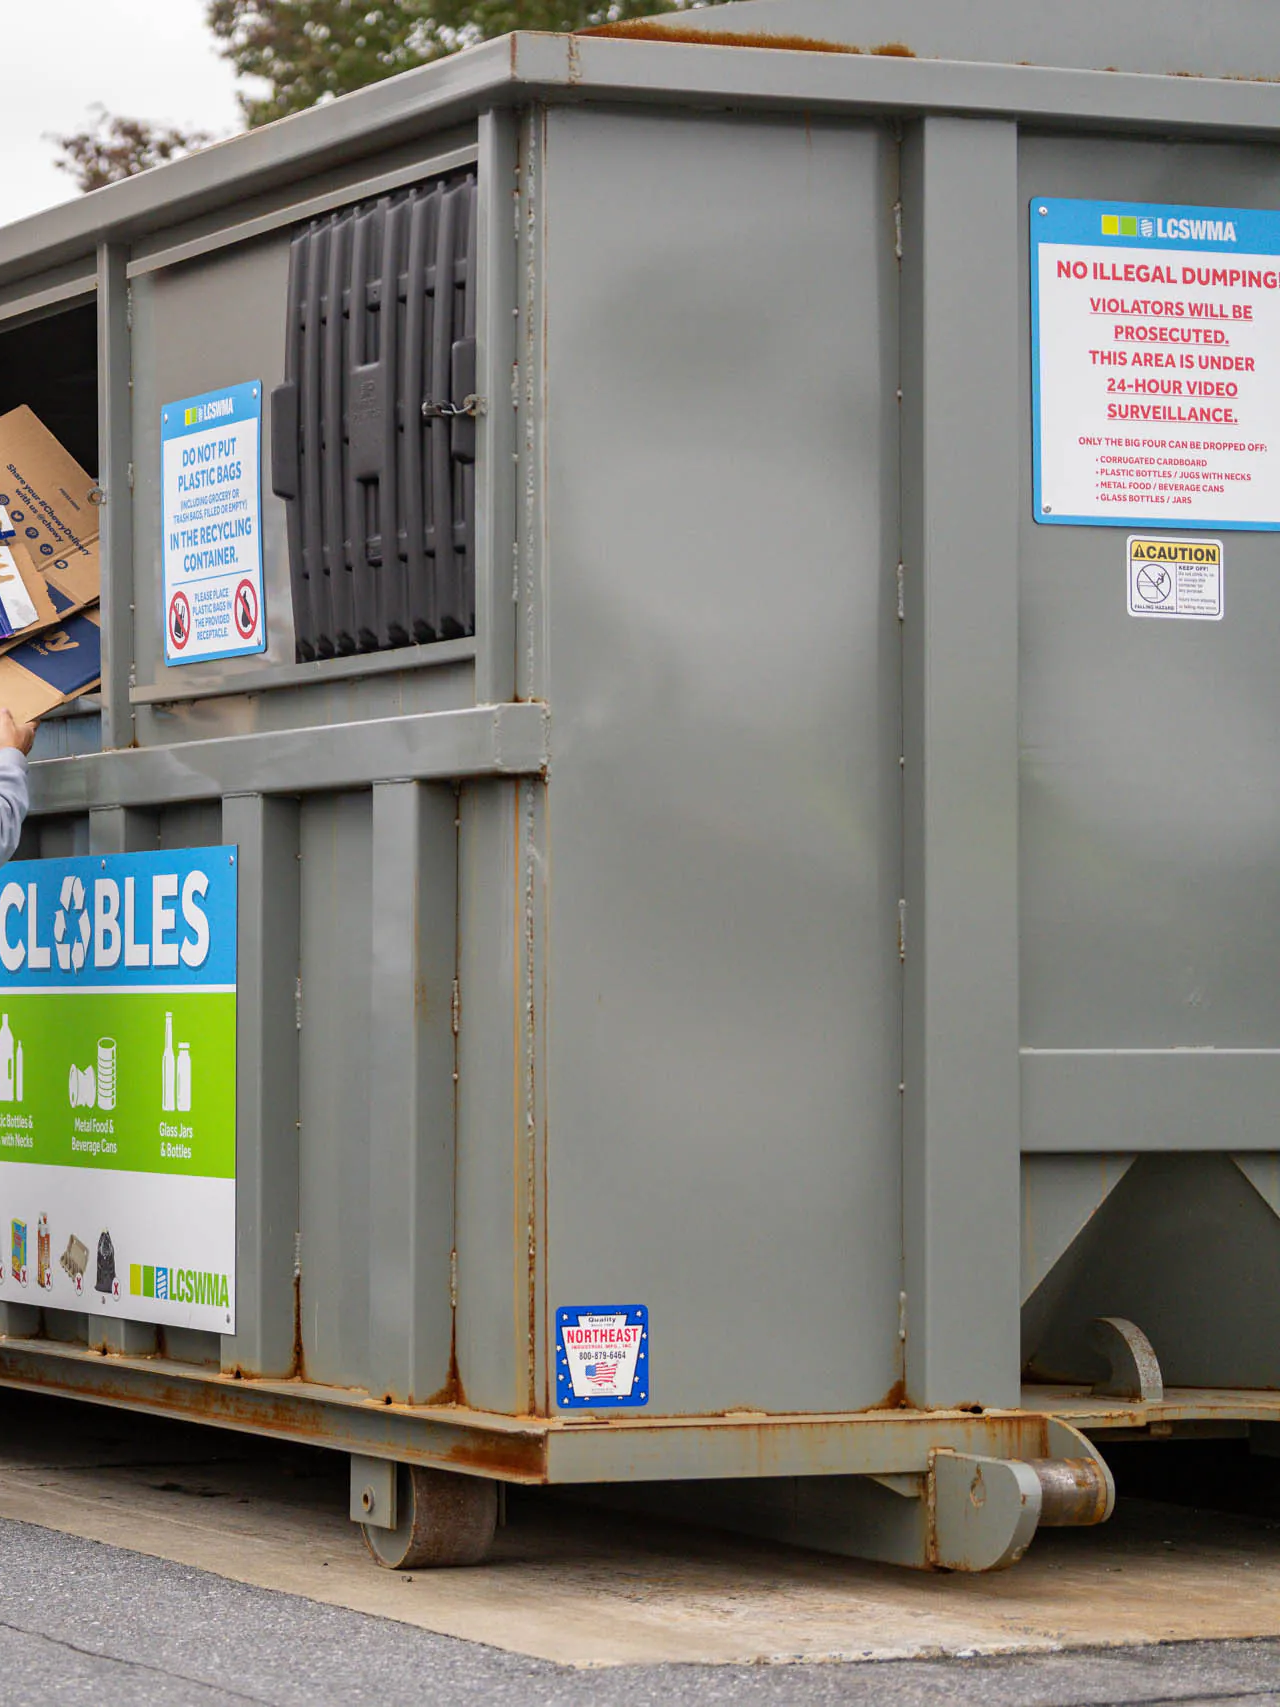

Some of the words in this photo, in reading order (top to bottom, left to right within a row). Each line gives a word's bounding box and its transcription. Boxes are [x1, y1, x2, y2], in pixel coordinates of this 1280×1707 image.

[1157, 218, 1236, 242] LCSWMA
[1057, 260, 1088, 279] NO
[1093, 262, 1177, 284] ILLEGAL
[1089, 297, 1185, 317] VIOLATORS
[1188, 302, 1229, 318] WILL
[1232, 304, 1253, 319] BE
[1114, 325, 1230, 344] PROSECUTED.
[1089, 350, 1128, 366] THIS
[1131, 352, 1176, 368] AREA
[1179, 354, 1195, 369] IS
[1198, 355, 1255, 372] UNDER
[1107, 377, 1182, 395] 24-HOUR
[1186, 380, 1238, 397] VIDEO
[1107, 403, 1238, 423] SURVEILLANCE.
[182, 447, 196, 468] DO
[197, 441, 217, 463] NOT
[218, 437, 237, 459] PUT
[1078, 436, 1103, 446] ONLY
[1104, 437, 1123, 447] THE
[1124, 438, 1140, 448] BIG
[1142, 439, 1167, 449] FOUR
[1169, 440, 1188, 449] CAN
[1190, 441, 1202, 450] BE
[1202, 441, 1246, 452] DROPPED
[1247, 443, 1268, 452] OFF:
[1100, 456, 1155, 465] CORRUGATED
[1156, 457, 1208, 467] CARDBOARD
[6, 463, 26, 485] Share
[22, 483, 41, 502] your
[177, 467, 215, 493] PLASTIC
[217, 460, 242, 484] BAGS
[1100, 468, 1134, 478] PLASTIC
[1135, 469, 1172, 479] BOTTLES
[1179, 471, 1200, 480] JUGS
[1201, 471, 1223, 480] WITH
[1224, 472, 1252, 481] NECKS
[1100, 481, 1127, 490] METAL
[1128, 482, 1152, 490] FOOD
[1158, 483, 1201, 493] BEVERAGE
[1202, 484, 1225, 493] CANS
[15, 488, 31, 506] with
[29, 503, 39, 515] us
[1100, 494, 1127, 502] GLASS
[1128, 495, 1165, 504] BOTTLES
[1172, 496, 1192, 504] JARS
[170, 532, 179, 551] IN
[181, 528, 199, 548] THE
[200, 517, 252, 545] RECYCLING
[184, 546, 238, 573] CONTAINER.
[1146, 545, 1216, 562] CAUTION
[194, 590, 212, 603] PLEASE
[212, 587, 229, 600] PLACE
[192, 603, 212, 616] PLASTIC
[212, 601, 226, 613] BAGS
[226, 600, 232, 609] IN
[195, 618, 205, 629] THE
[7, 1113, 28, 1129] Bottles
[28, 1115, 33, 1129] &
[74, 1118, 92, 1133] Metal
[93, 1118, 109, 1133] Food
[109, 1119, 114, 1134] &
[159, 1121, 178, 1137] Glass
[179, 1123, 193, 1139] Jars
[1, 1132, 15, 1147] with
[15, 1133, 33, 1148] Necks
[72, 1136, 101, 1156] Beverage
[101, 1139, 118, 1154] Cans
[161, 1142, 166, 1157] &
[167, 1142, 192, 1159] Bottles
[169, 1267, 229, 1308] LCSWMA
[588, 1316, 616, 1324] Quality
[567, 1328, 639, 1344] NORTHEAST
[579, 1351, 626, 1361] 800-879-6464
